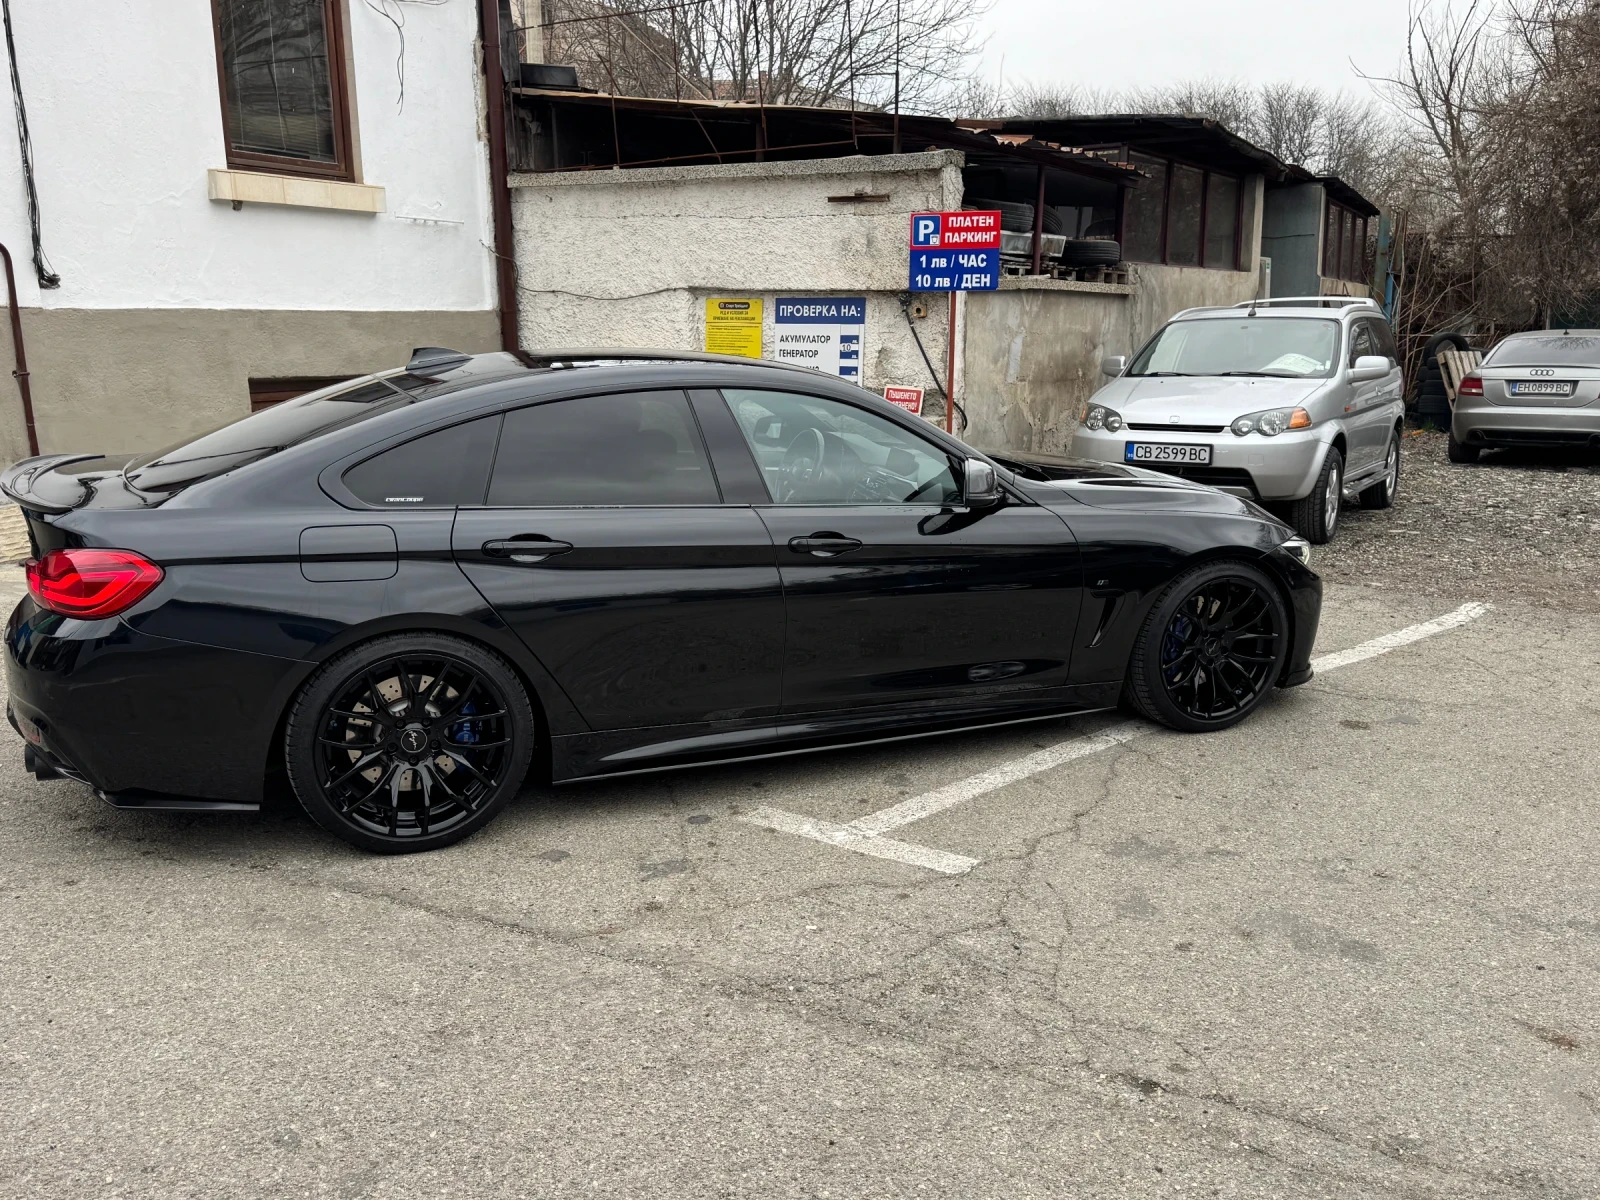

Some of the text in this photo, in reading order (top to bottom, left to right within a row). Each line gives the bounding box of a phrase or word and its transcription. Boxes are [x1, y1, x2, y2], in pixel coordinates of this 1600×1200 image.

[948, 215, 994, 228] ПЛАТЕН
[918, 220, 935, 242] P
[944, 231, 998, 243] ПАРКИНГ
[920, 254, 927, 268] 1
[930, 257, 948, 268] лв
[958, 253, 987, 268] ЧАС
[915, 274, 931, 287] 10
[934, 277, 951, 287] лв
[961, 273, 991, 289] ДЕН
[779, 305, 861, 317] ПРОВЕРКА НА:
[779, 335, 831, 344] АКУМУЛАТОР
[779, 349, 819, 358] ГЕНЕРАТОР
[841, 344, 852, 352] 10
[1531, 383, 1555, 392] 0899
[1555, 383, 1569, 393] BC
[1135, 445, 1152, 459] CB
[1154, 446, 1187, 460] 2599
[1188, 448, 1207, 462] BC
